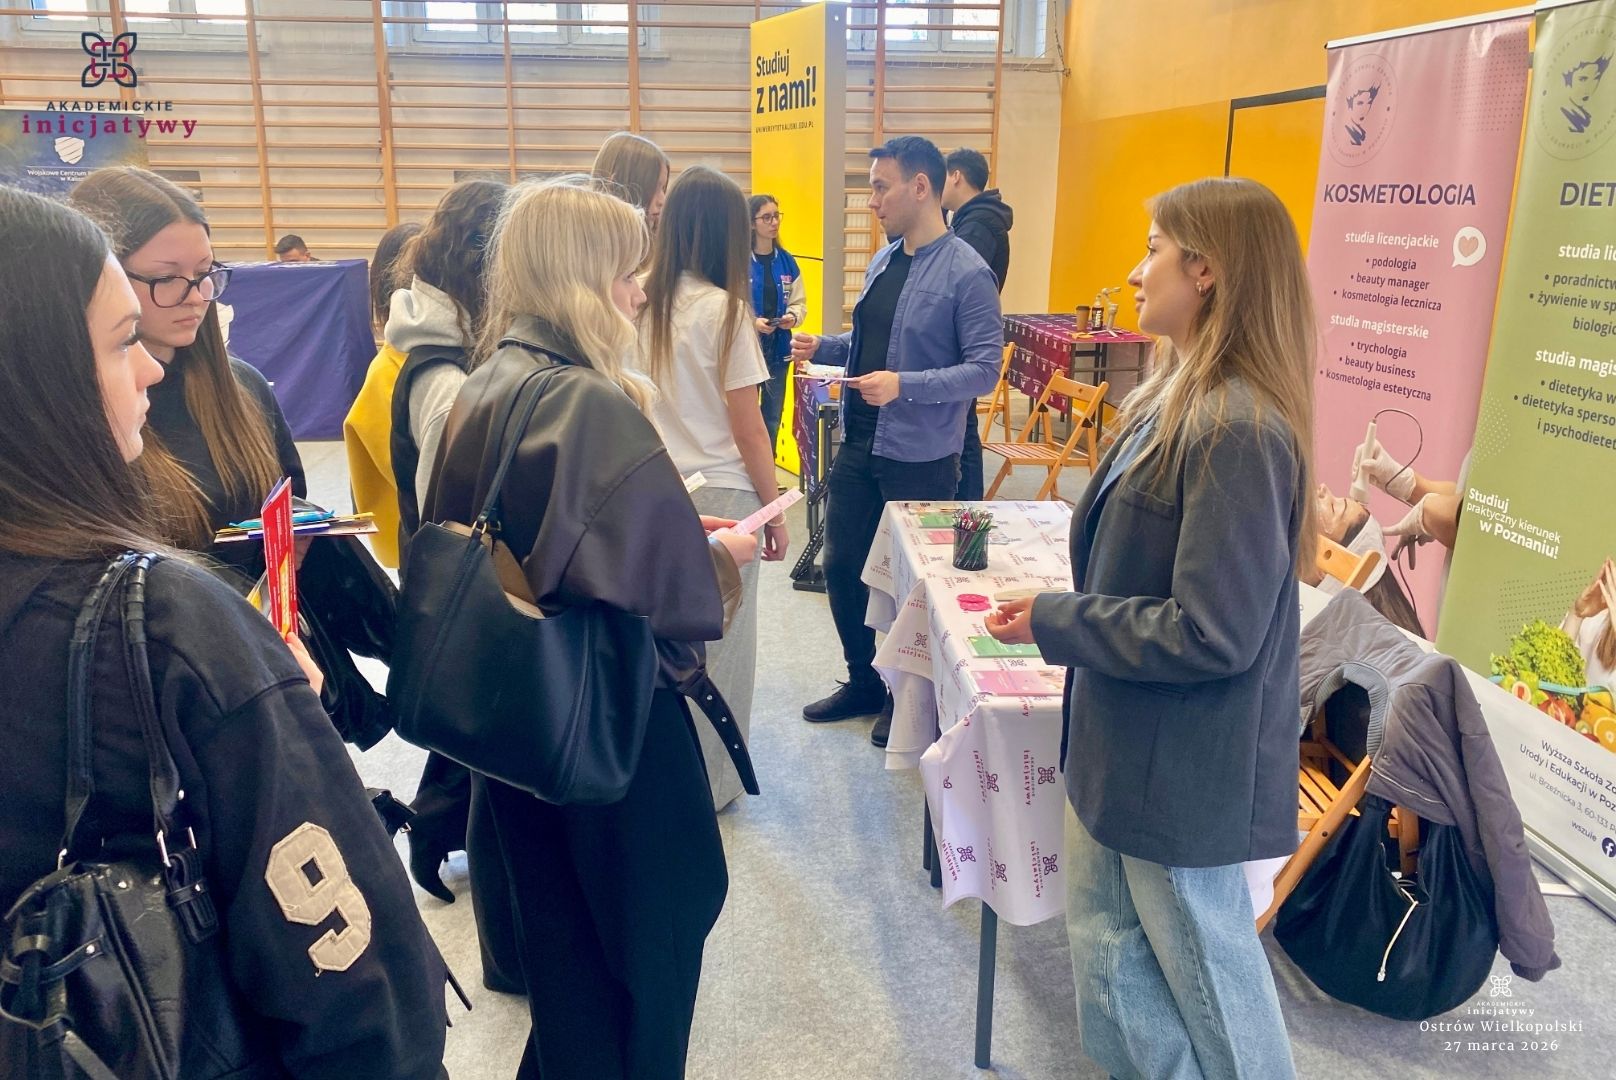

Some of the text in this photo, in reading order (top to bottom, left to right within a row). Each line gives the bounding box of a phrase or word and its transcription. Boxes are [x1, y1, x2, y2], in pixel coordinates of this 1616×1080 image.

[756, 49, 790, 77] Studiuj
[756, 66, 817, 114] z nami!
[1323, 184, 1477, 206] KOSMETOLOGIA
[1345, 231, 1439, 249] studia licencjackie
[1558, 243, 1601, 260] studia
[1371, 257, 1417, 272] podologia
[1356, 272, 1430, 292] beauty manager
[1341, 289, 1442, 311] kosmetologia lecznicza
[1537, 290, 1588, 307] żywienie
[1590, 299, 1601, 310] w
[1330, 314, 1429, 339] studia magisterskie
[1357, 341, 1407, 359] trychologia
[1535, 349, 1576, 368] studia
[1345, 355, 1416, 379] beauty business
[1326, 368, 1432, 401] kosmetologia estetyczna
[1548, 379, 1603, 401] dietetyka
[1522, 394, 1574, 416] dietetyka
[1537, 418, 1541, 430] i
[1468, 488, 1510, 514] Studiuj
[1466, 501, 1561, 544] praktyczny kierunek
[1479, 520, 1559, 560] w Poznaniu!
[1520, 743, 1544, 766] Urody
[1549, 763, 1588, 793] Edukacji
[1588, 788, 1598, 799] w
[1541, 740, 1573, 767] Wyższa
[1574, 761, 1604, 786] Szkoła
[1023, 750, 1031, 806] inicjatywy
[1538, 776, 1576, 807] Brzeźnicka
[1584, 807, 1609, 828] 60-133
[1571, 820, 1597, 842] wszuie
[1030, 841, 1041, 899] inicjatywy
[264, 821, 372, 972] 9
